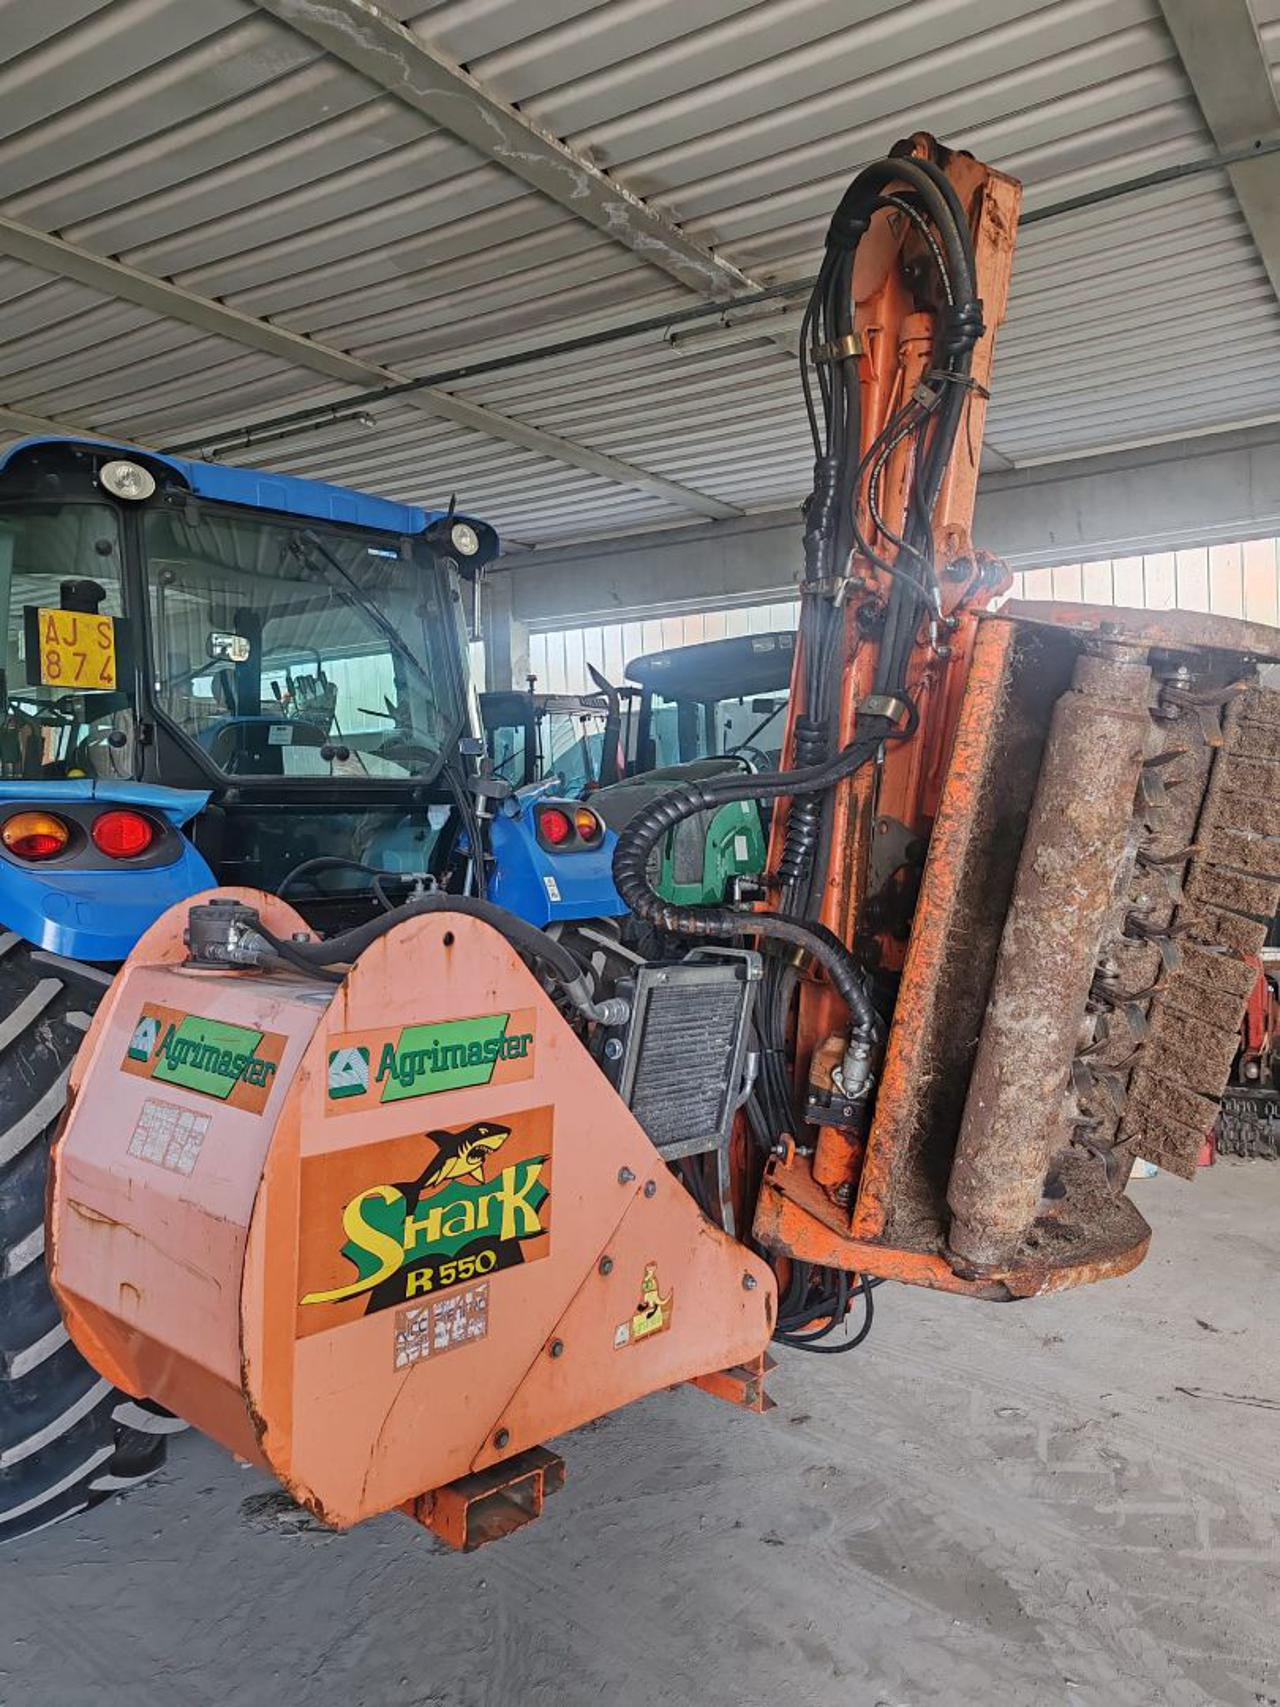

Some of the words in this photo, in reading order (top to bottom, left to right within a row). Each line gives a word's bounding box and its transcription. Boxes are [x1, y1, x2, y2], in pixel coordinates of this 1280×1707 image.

[46, 650, 113, 683] 874
[155, 1023, 277, 1087] Agrimaster
[376, 1033, 533, 1087] Agrimaster
[406, 1269, 433, 1298] R
[439, 1250, 497, 1285] 550
